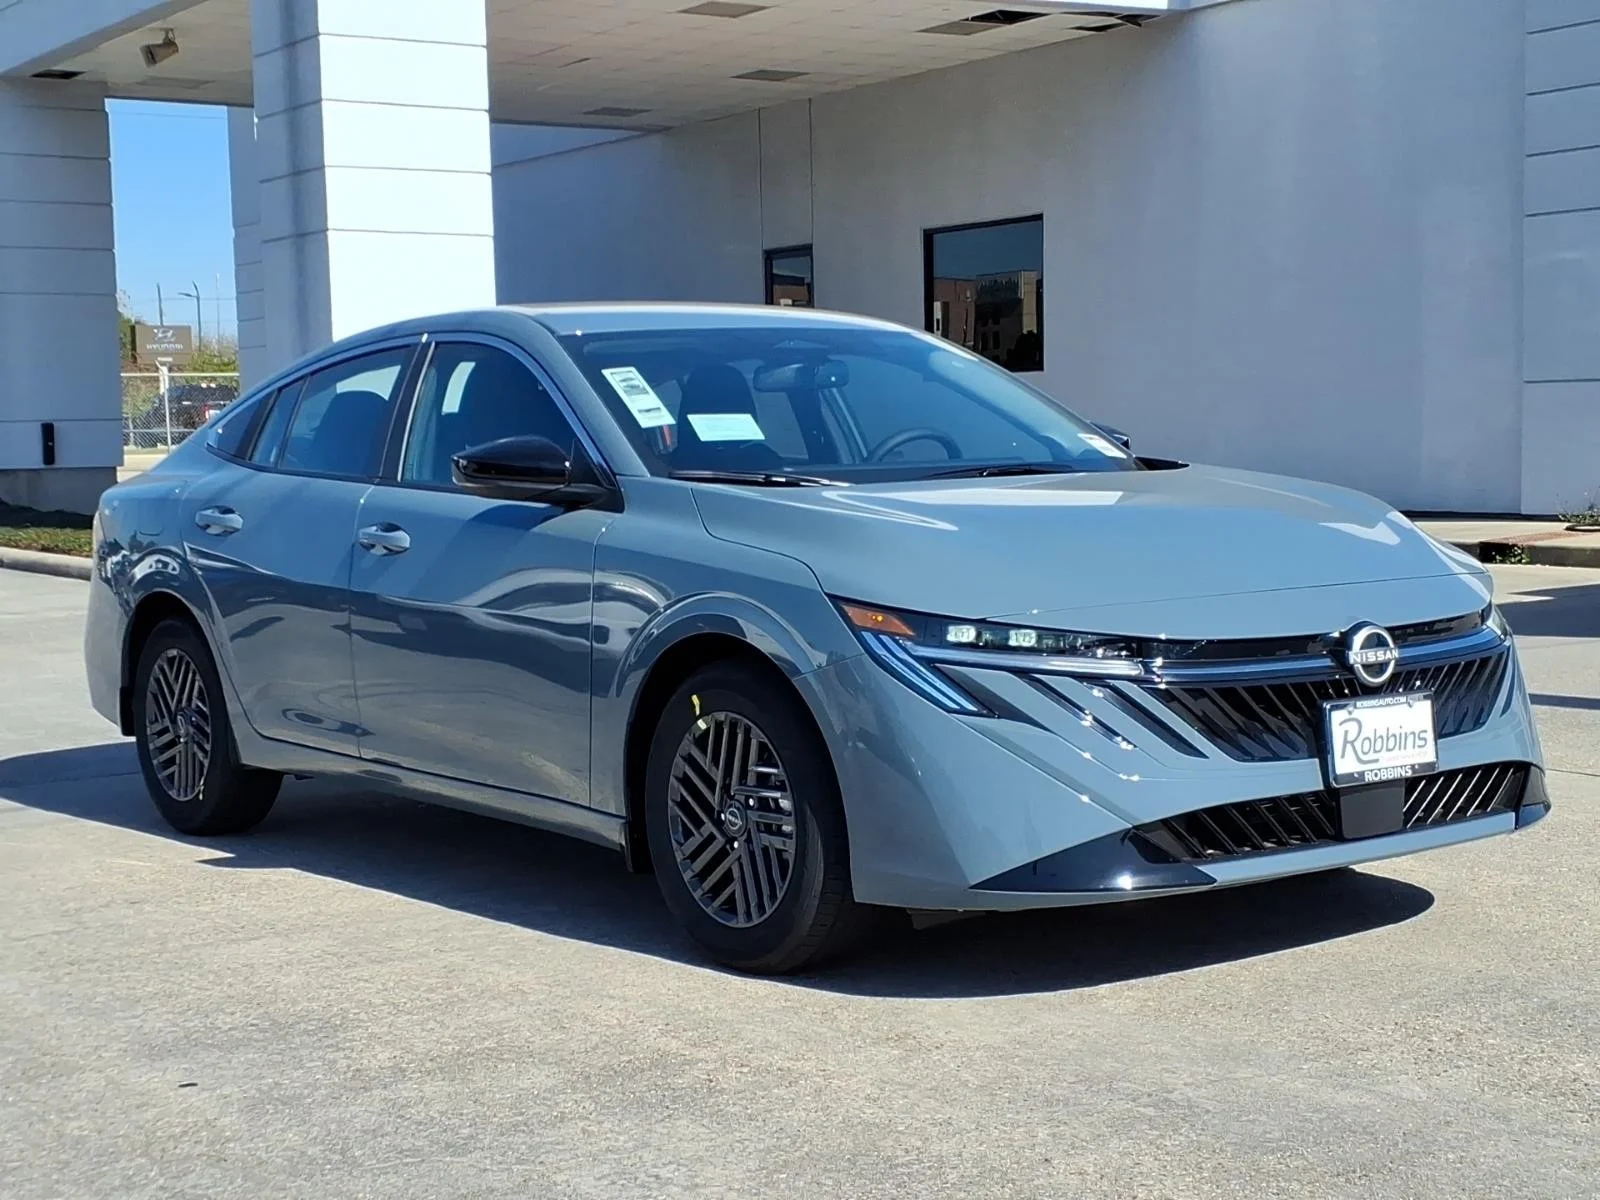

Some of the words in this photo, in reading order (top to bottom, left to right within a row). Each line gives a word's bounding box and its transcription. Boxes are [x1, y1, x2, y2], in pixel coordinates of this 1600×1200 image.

[1350, 649, 1399, 664] NISSAN
[1339, 717, 1428, 765] Robbins
[1364, 765, 1412, 782] ROBBINS
